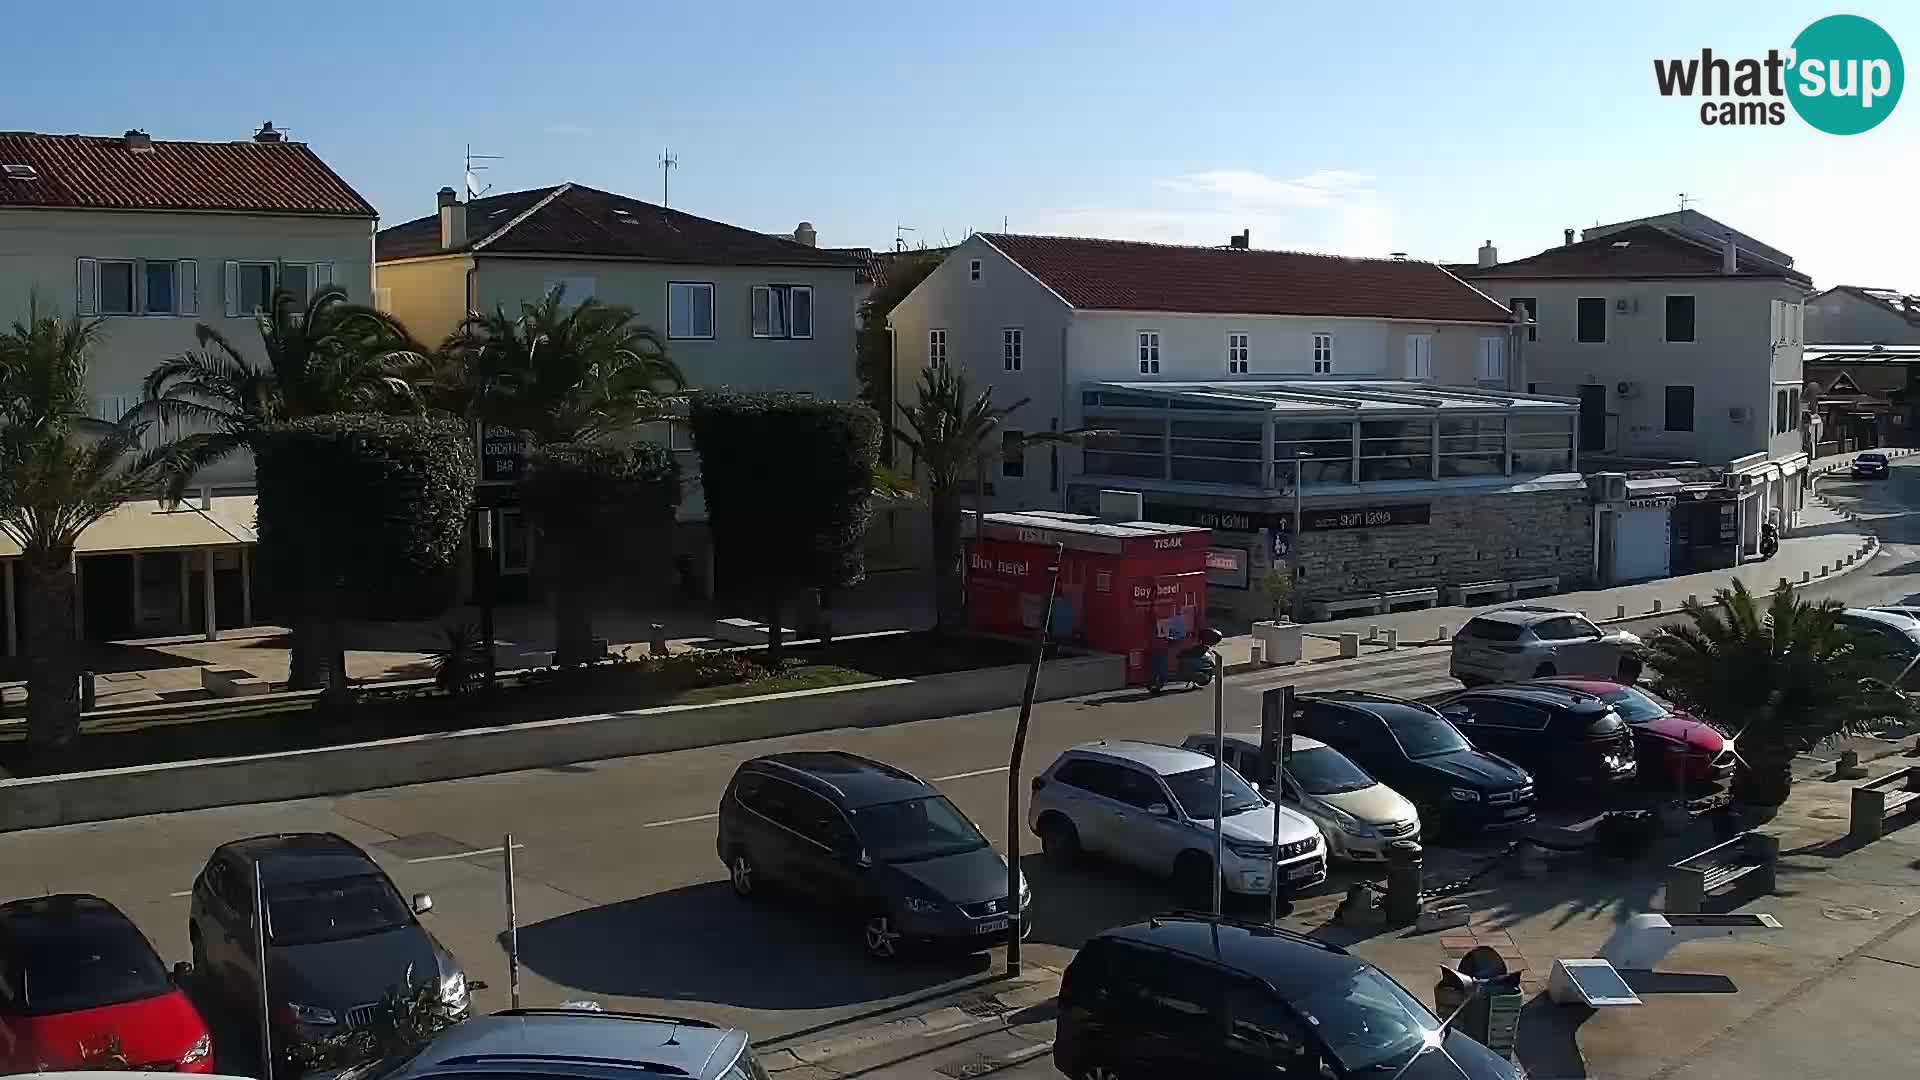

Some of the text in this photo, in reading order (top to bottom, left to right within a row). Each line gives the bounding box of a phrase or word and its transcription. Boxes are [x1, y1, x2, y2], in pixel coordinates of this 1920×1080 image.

[496, 460, 514, 472] BAR
[1153, 537, 1183, 549] TISAK
[997, 560, 1030, 576] here!
[1133, 585, 1152, 598] Buy
